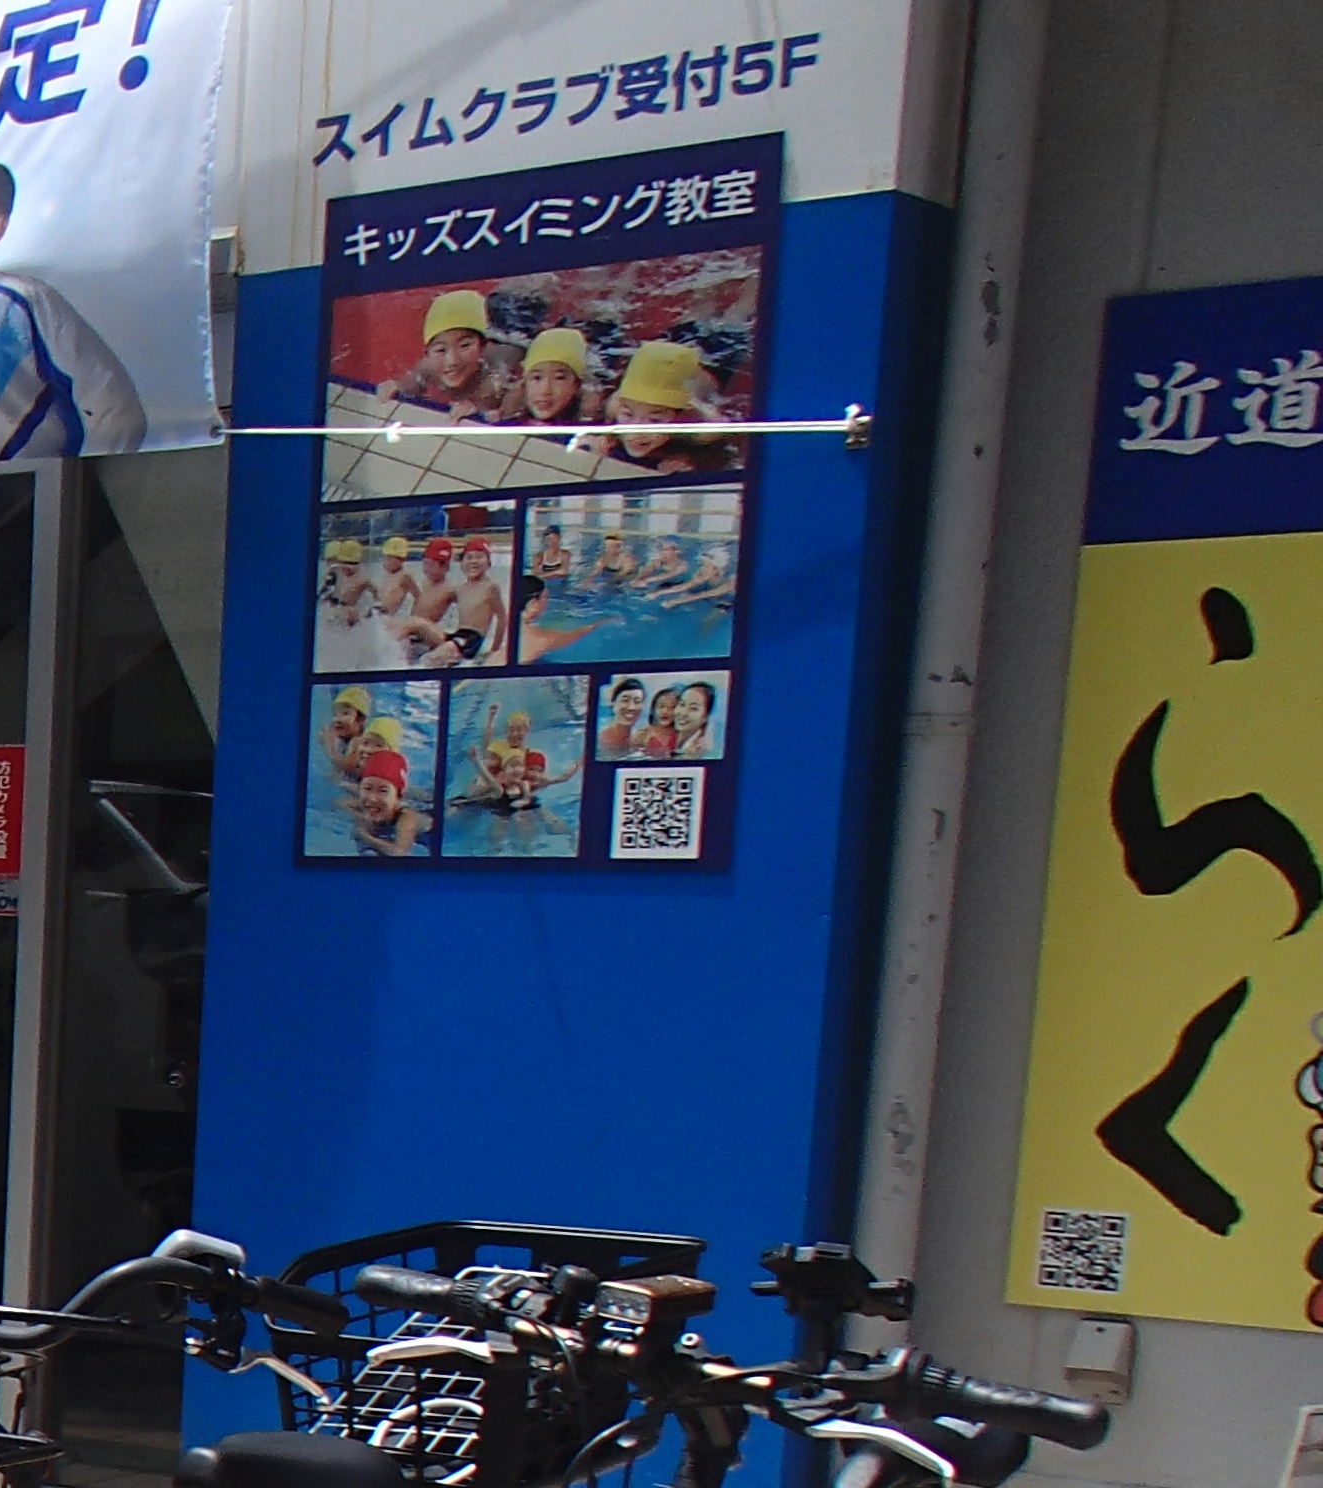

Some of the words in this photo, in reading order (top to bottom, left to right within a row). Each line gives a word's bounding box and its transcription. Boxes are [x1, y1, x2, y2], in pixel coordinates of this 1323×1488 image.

[312, 33, 821, 167] スイムクラブ受付5F
[342, 169, 757, 267] キッズスイミング教室
[1119, 349, 1323, 456] 近道
